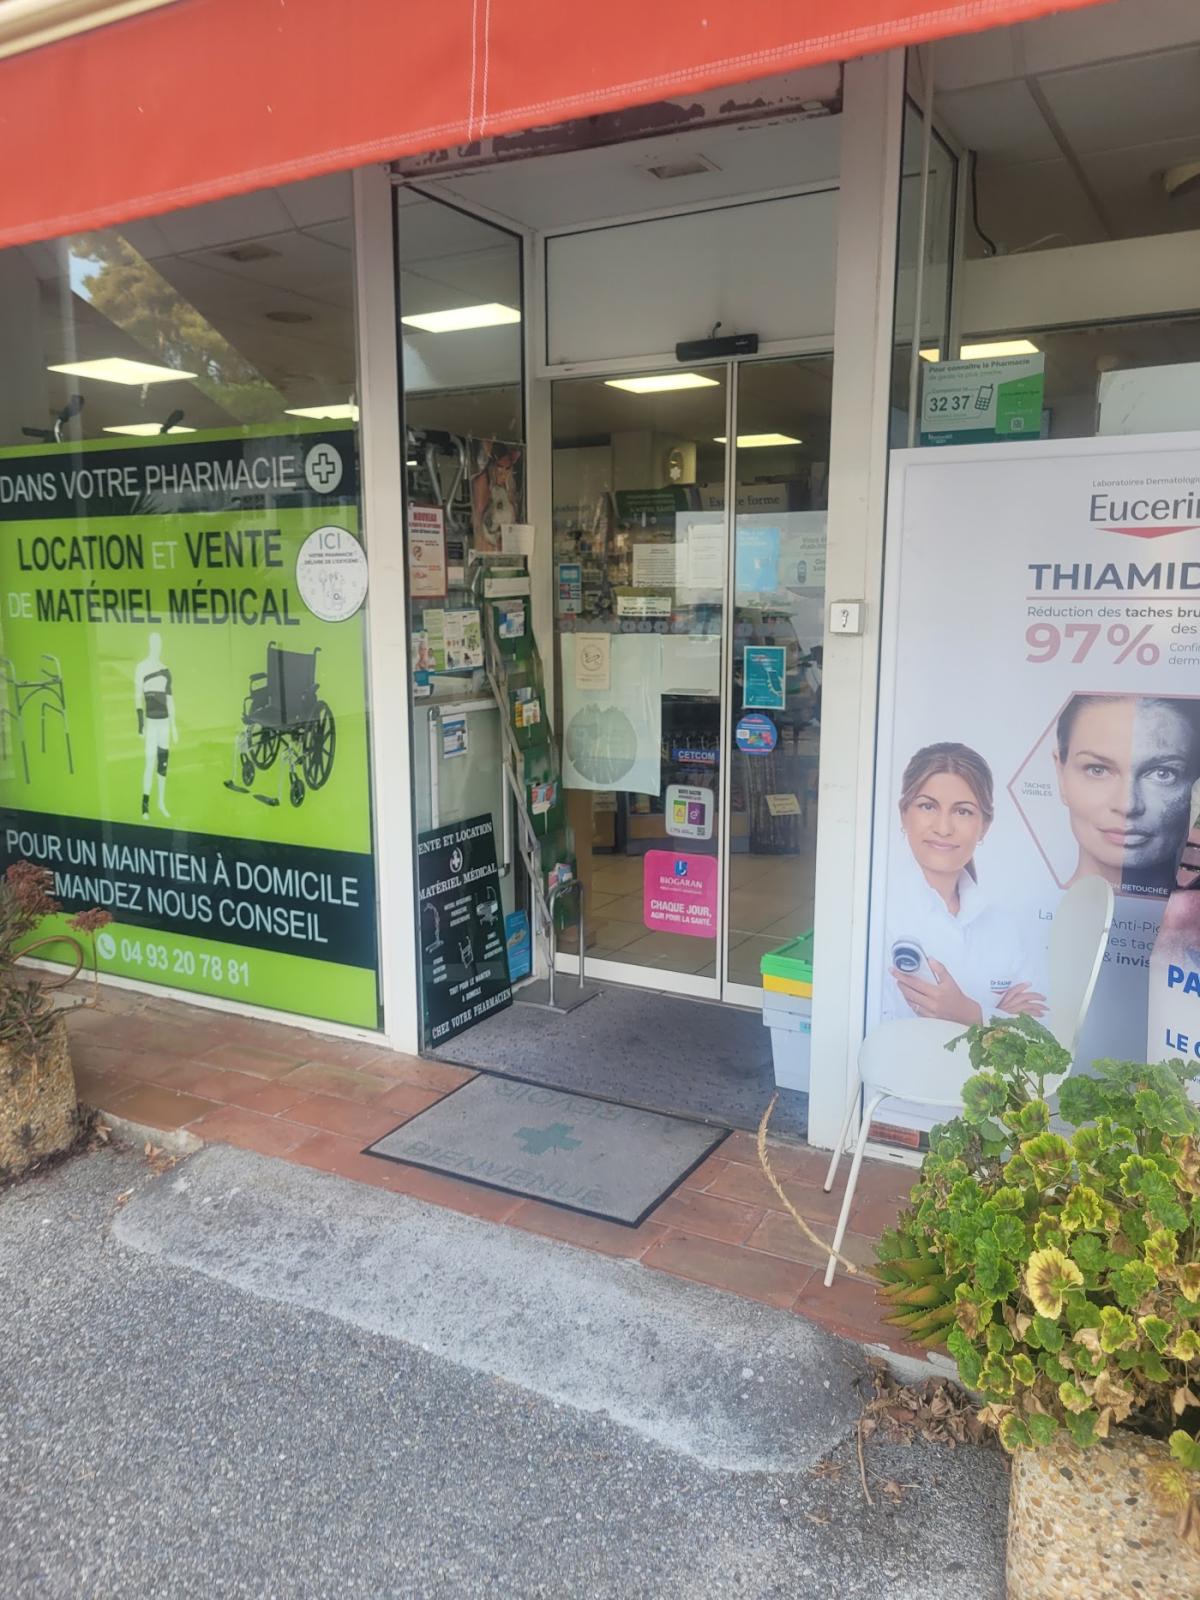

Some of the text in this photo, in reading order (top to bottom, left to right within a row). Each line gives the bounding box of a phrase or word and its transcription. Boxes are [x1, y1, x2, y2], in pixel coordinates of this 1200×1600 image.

[991, 359, 1031, 369] Pharmacie
[929, 395, 970, 412] 32 37
[0, 455, 297, 503] DANS VOTRE PHARMACIE
[1092, 479, 1145, 488] Laboratoires
[17, 529, 284, 571] LOCATION ET VENTE
[319, 532, 341, 550] ICI
[1028, 561, 1200, 592] THIAMID
[8, 579, 300, 626] DE MATÉRIEL MÉDICAL
[1027, 606, 1200, 618] Réduction des taches bru
[1171, 623, 1198, 634] des
[1022, 788, 1053, 797] VISIBLES
[1023, 781, 1051, 790] TACHES
[417, 822, 493, 855] ENTE ET LOCATION
[6, 828, 360, 908] POUR UN MAINTIEN À DOMICILE
[419, 863, 497, 900] MATÉRIEL MÉDICAL
[660, 876, 703, 889] BIOGARAN
[1121, 883, 1169, 895] RETOUCHÉE
[44, 870, 328, 944] EMANDEZ NOUS CONSEIL
[650, 899, 712, 919] CHAQUE JOUR,
[1038, 908, 1053, 921] La
[682, 915, 690, 924] LA
[121, 937, 249, 987] 04 93 20 78 81
[1103, 951, 1111, 962] &
[432, 987, 511, 1040] CHEZ VOTRE PHARMACIEN
[1166, 1028, 1189, 1054] LE
[402, 1140, 610, 1206] BIENVENUE
